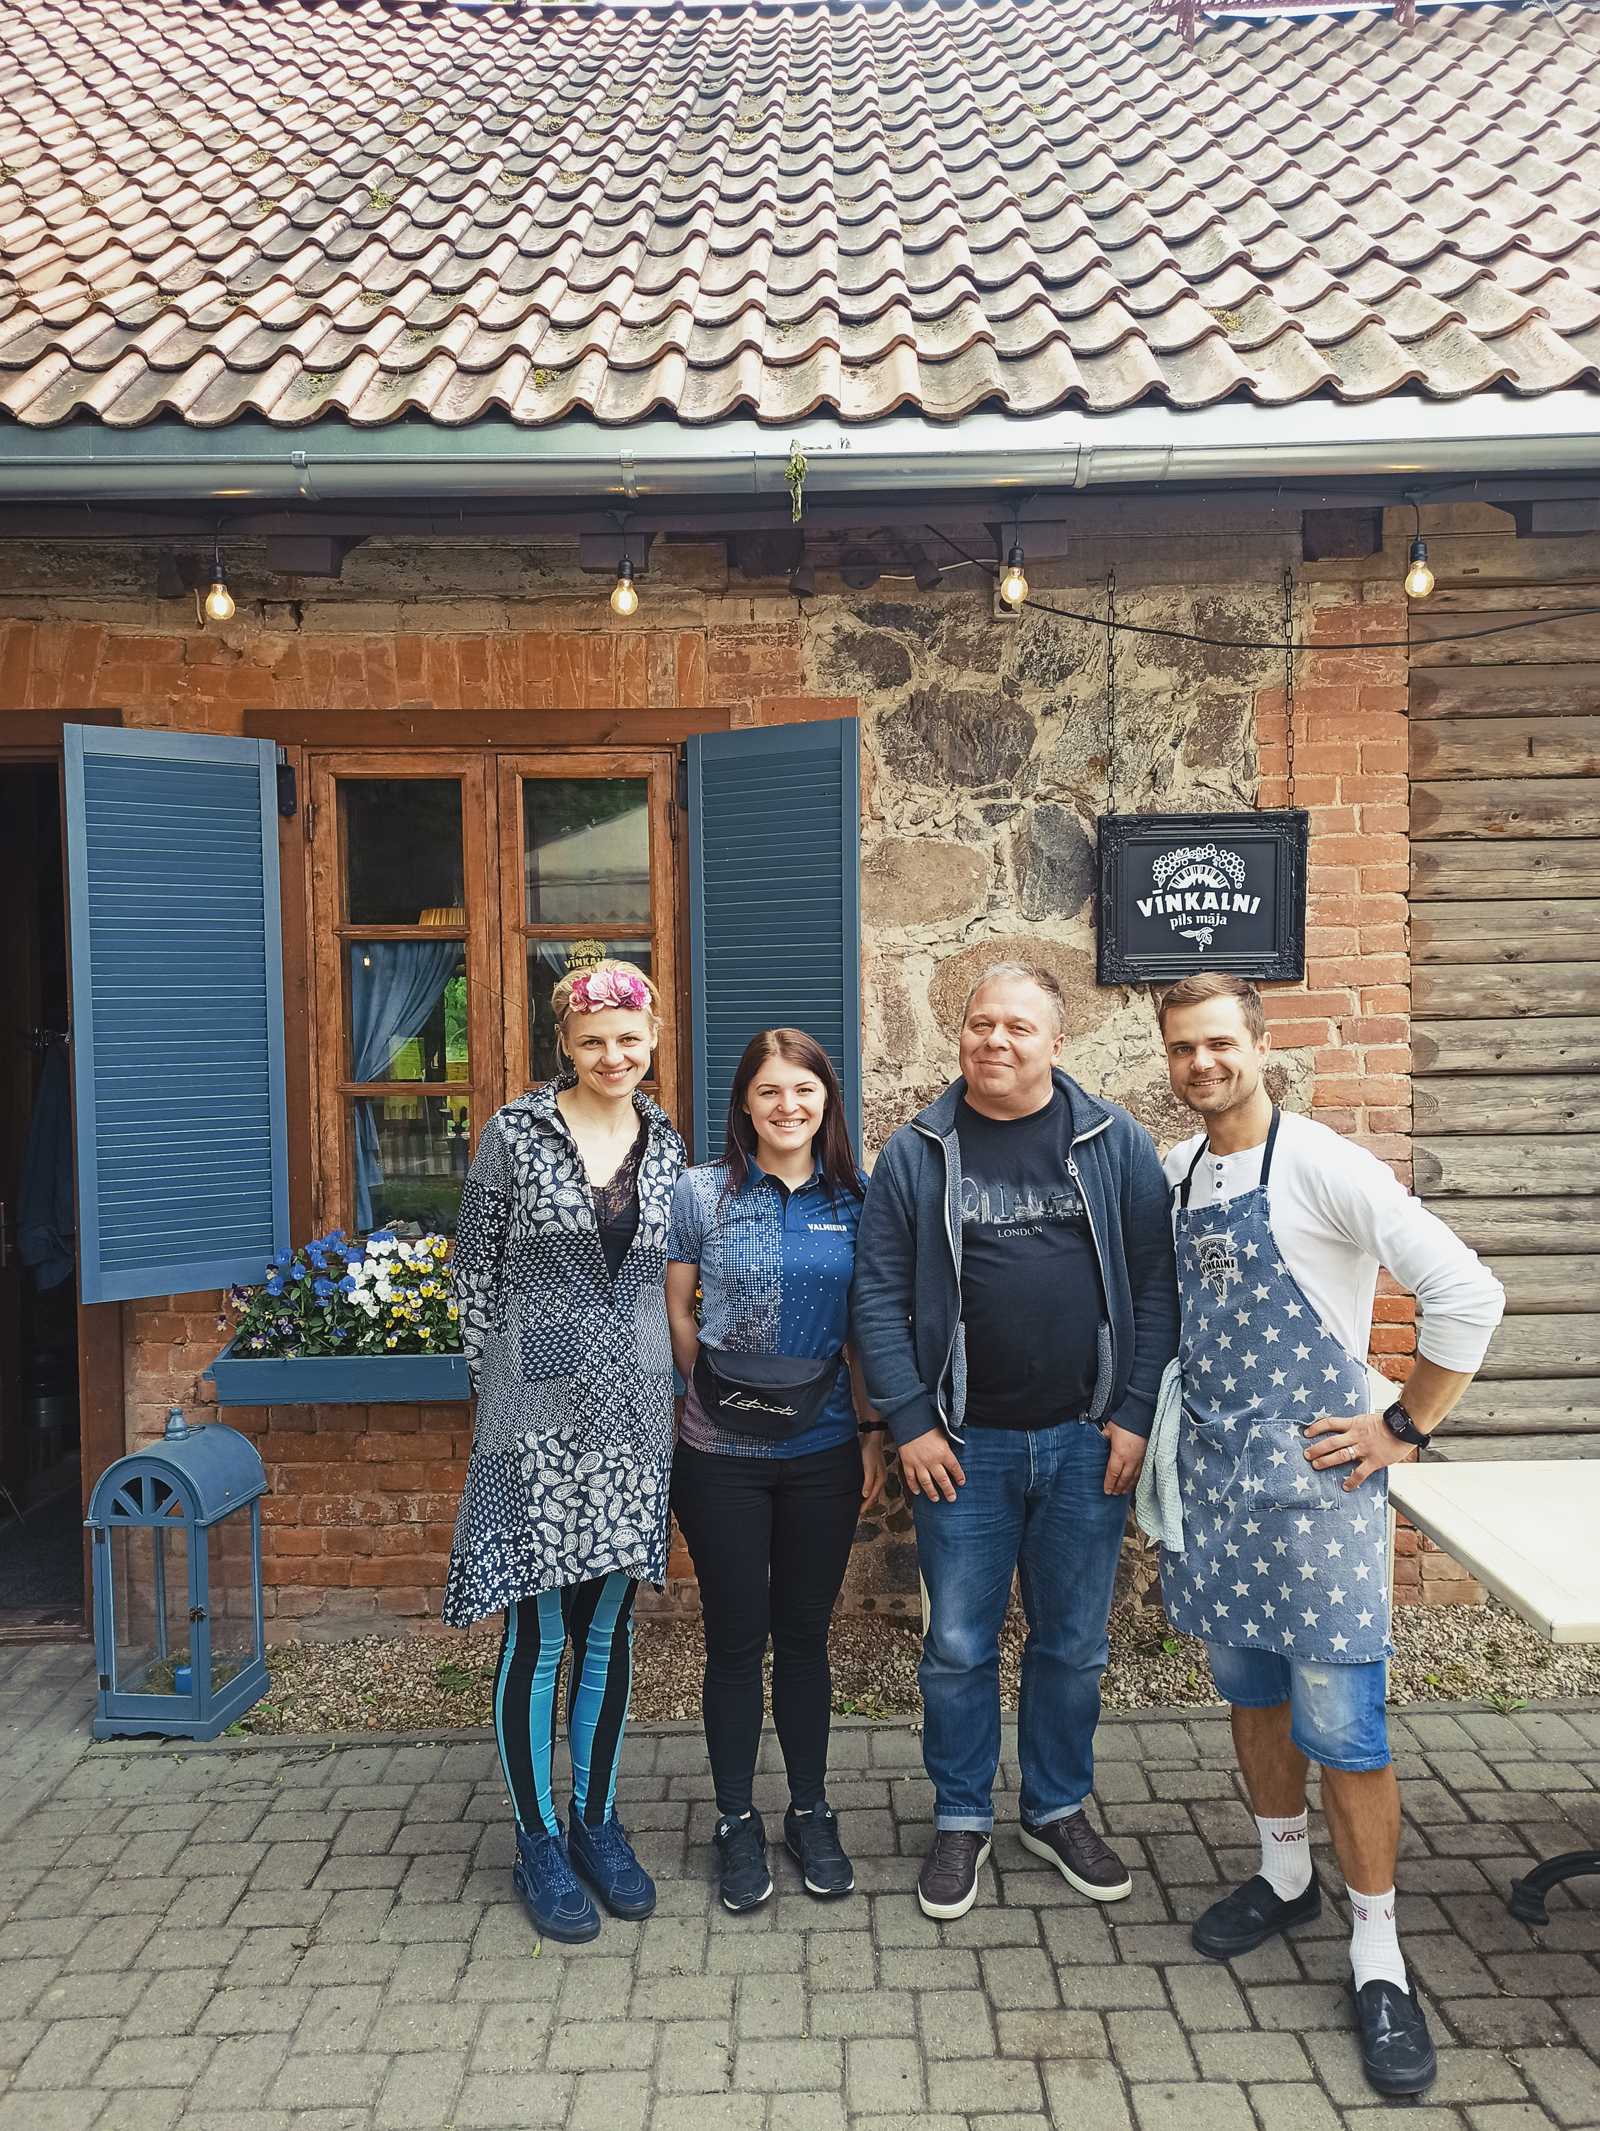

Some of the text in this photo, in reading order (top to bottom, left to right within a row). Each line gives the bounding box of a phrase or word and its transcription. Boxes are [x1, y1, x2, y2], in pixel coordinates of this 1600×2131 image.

[1136, 888, 1261, 918] VĪNKALNI
[1169, 912, 1228, 930] pils māja
[564, 956, 601, 969] VĪNKA
[807, 1223, 848, 1232] VALMIERA
[997, 1225, 1043, 1238] LONDON
